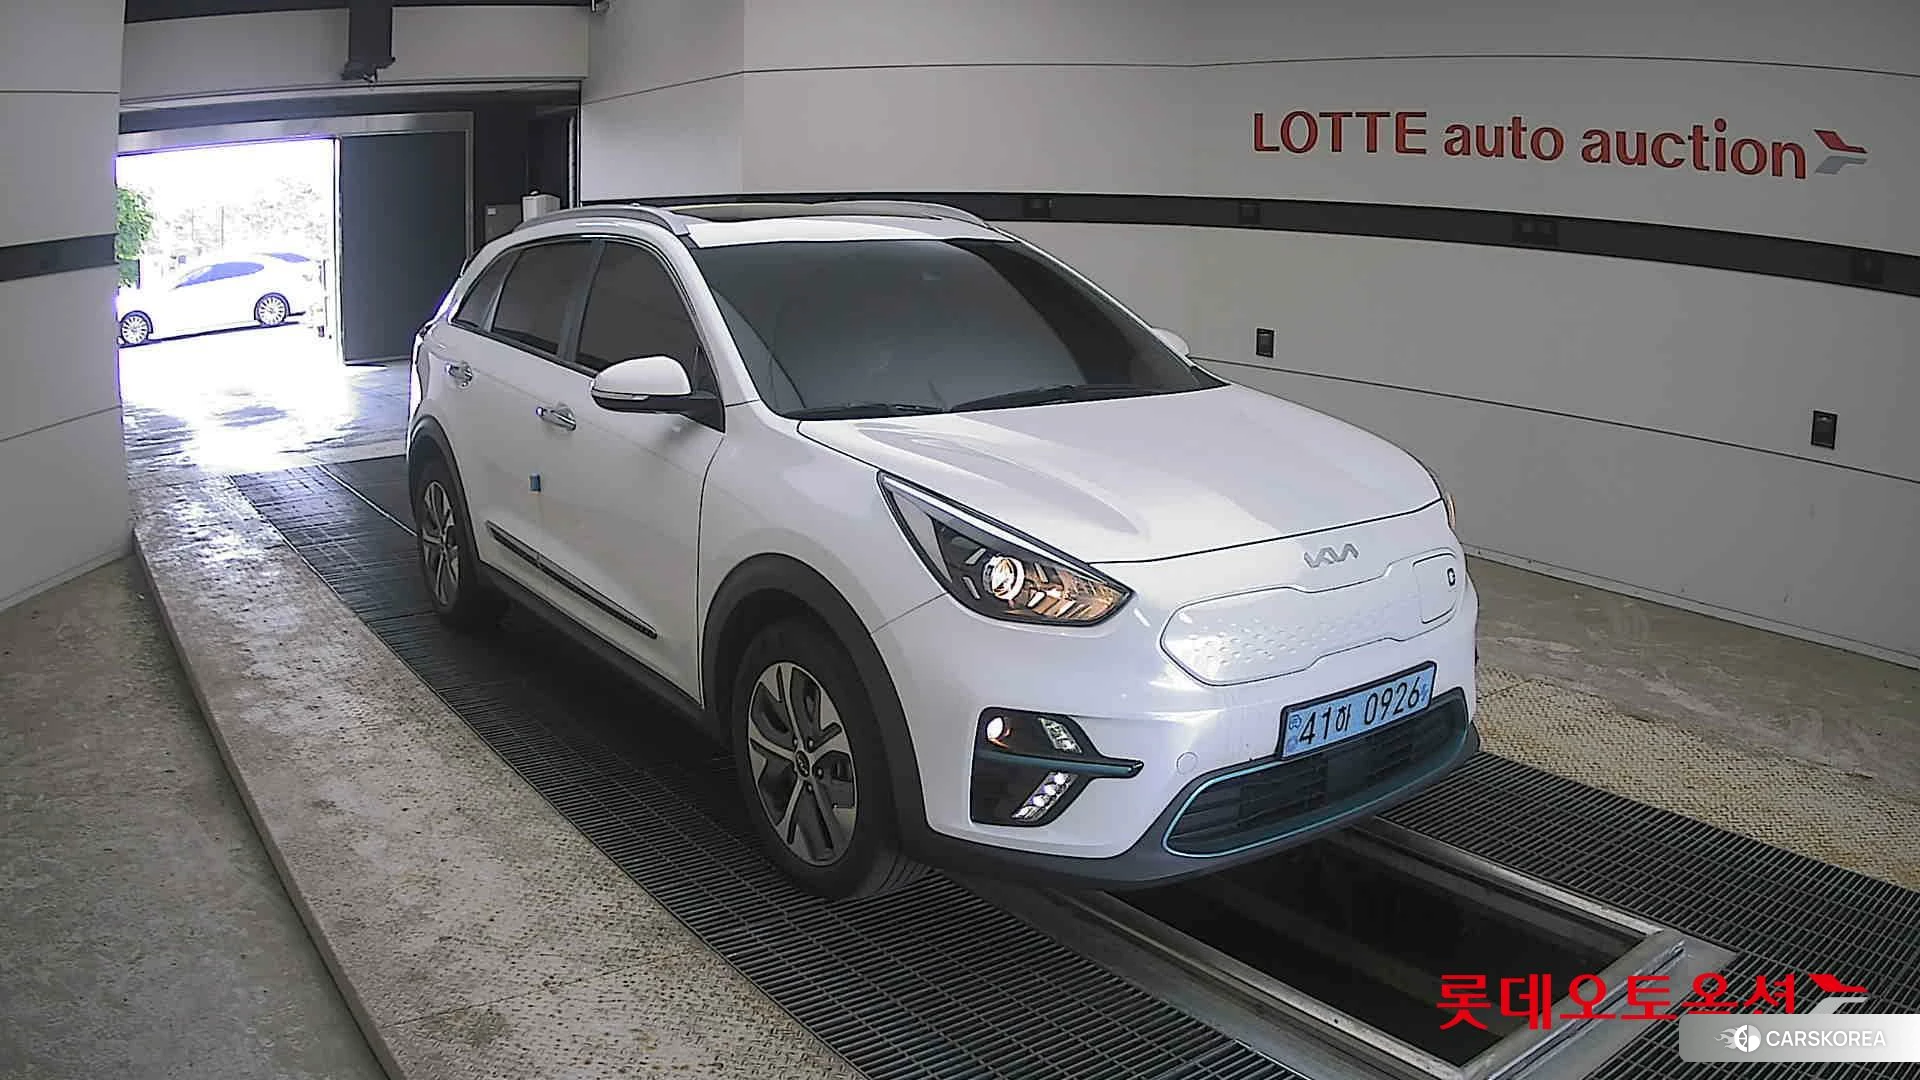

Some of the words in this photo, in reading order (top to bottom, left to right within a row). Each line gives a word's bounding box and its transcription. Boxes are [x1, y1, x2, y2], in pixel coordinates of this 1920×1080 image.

[1253, 110, 1428, 154] LOTTE
[1444, 115, 1565, 161] auto
[1581, 117, 1807, 180] auction
[1303, 543, 1360, 569] KIA
[1299, 703, 1352, 745] 41하
[1363, 676, 1421, 726] 0926
